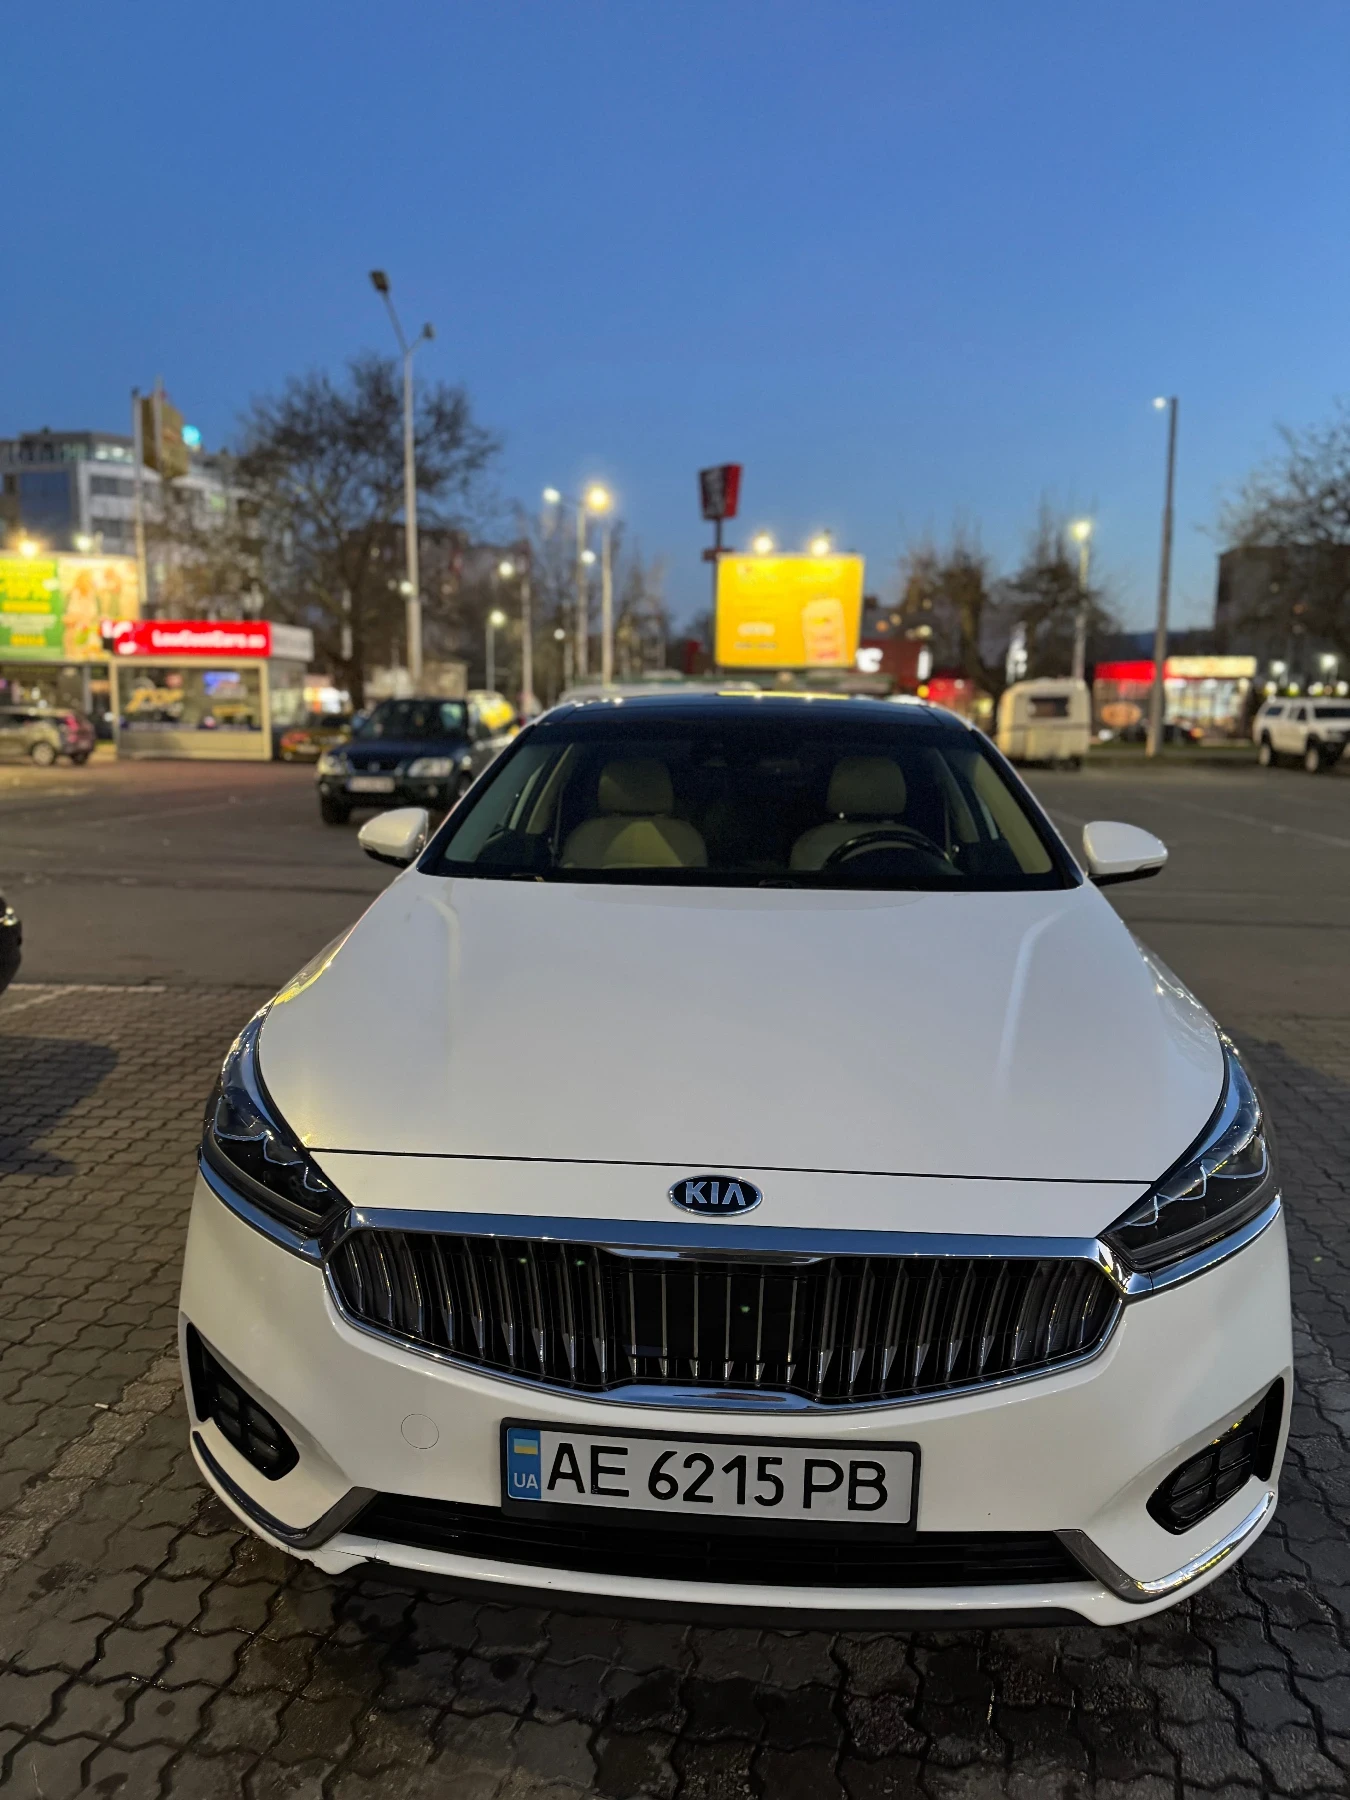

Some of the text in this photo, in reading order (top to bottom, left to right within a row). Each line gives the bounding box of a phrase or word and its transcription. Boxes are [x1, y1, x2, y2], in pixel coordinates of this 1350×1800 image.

[685, 1181, 746, 1206] KIA
[513, 1472, 539, 1490] UA
[547, 1442, 888, 1511] AE 6215 PB
